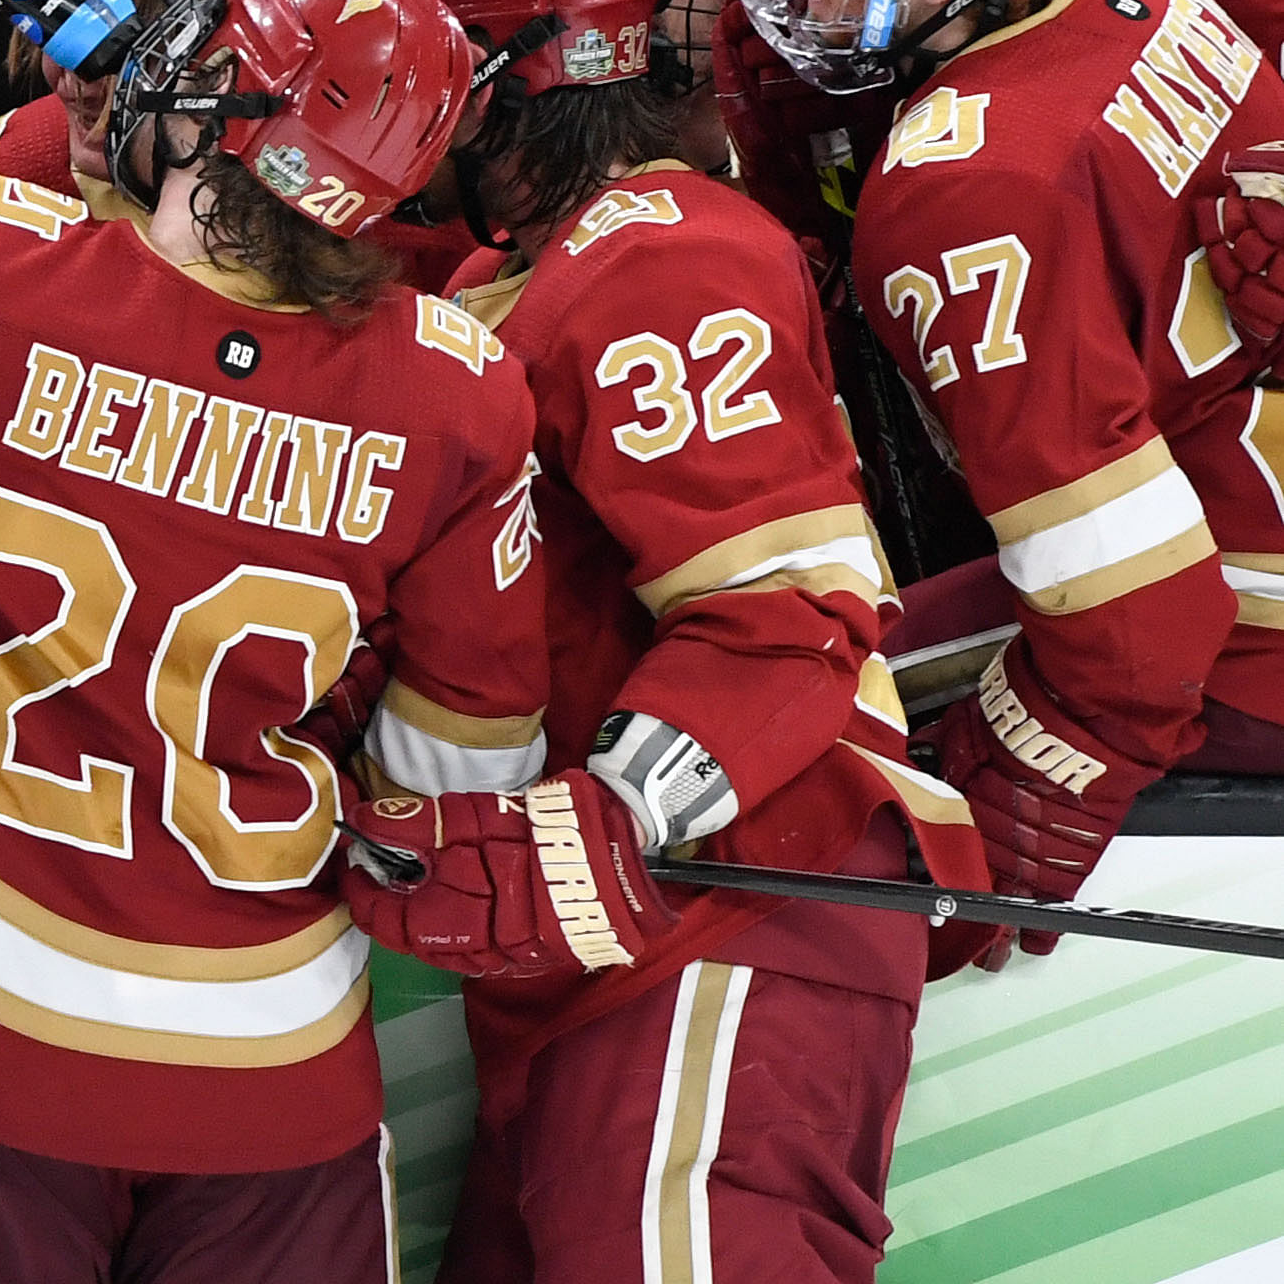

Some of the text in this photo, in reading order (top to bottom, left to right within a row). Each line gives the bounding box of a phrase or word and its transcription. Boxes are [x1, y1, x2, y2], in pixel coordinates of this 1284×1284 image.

[470, 50, 510, 90] AUER
[617, 22, 649, 74] 32
[298, 175, 365, 227] 20
[225, 339, 255, 370] RB
[883, 234, 1033, 393] 27
[594, 307, 782, 463] 32
[1, 341, 407, 545] BENNING
[977, 638, 1108, 795] RRIOR
[524, 781, 636, 973] WARRIO
[610, 841, 644, 914] PIONEERS
